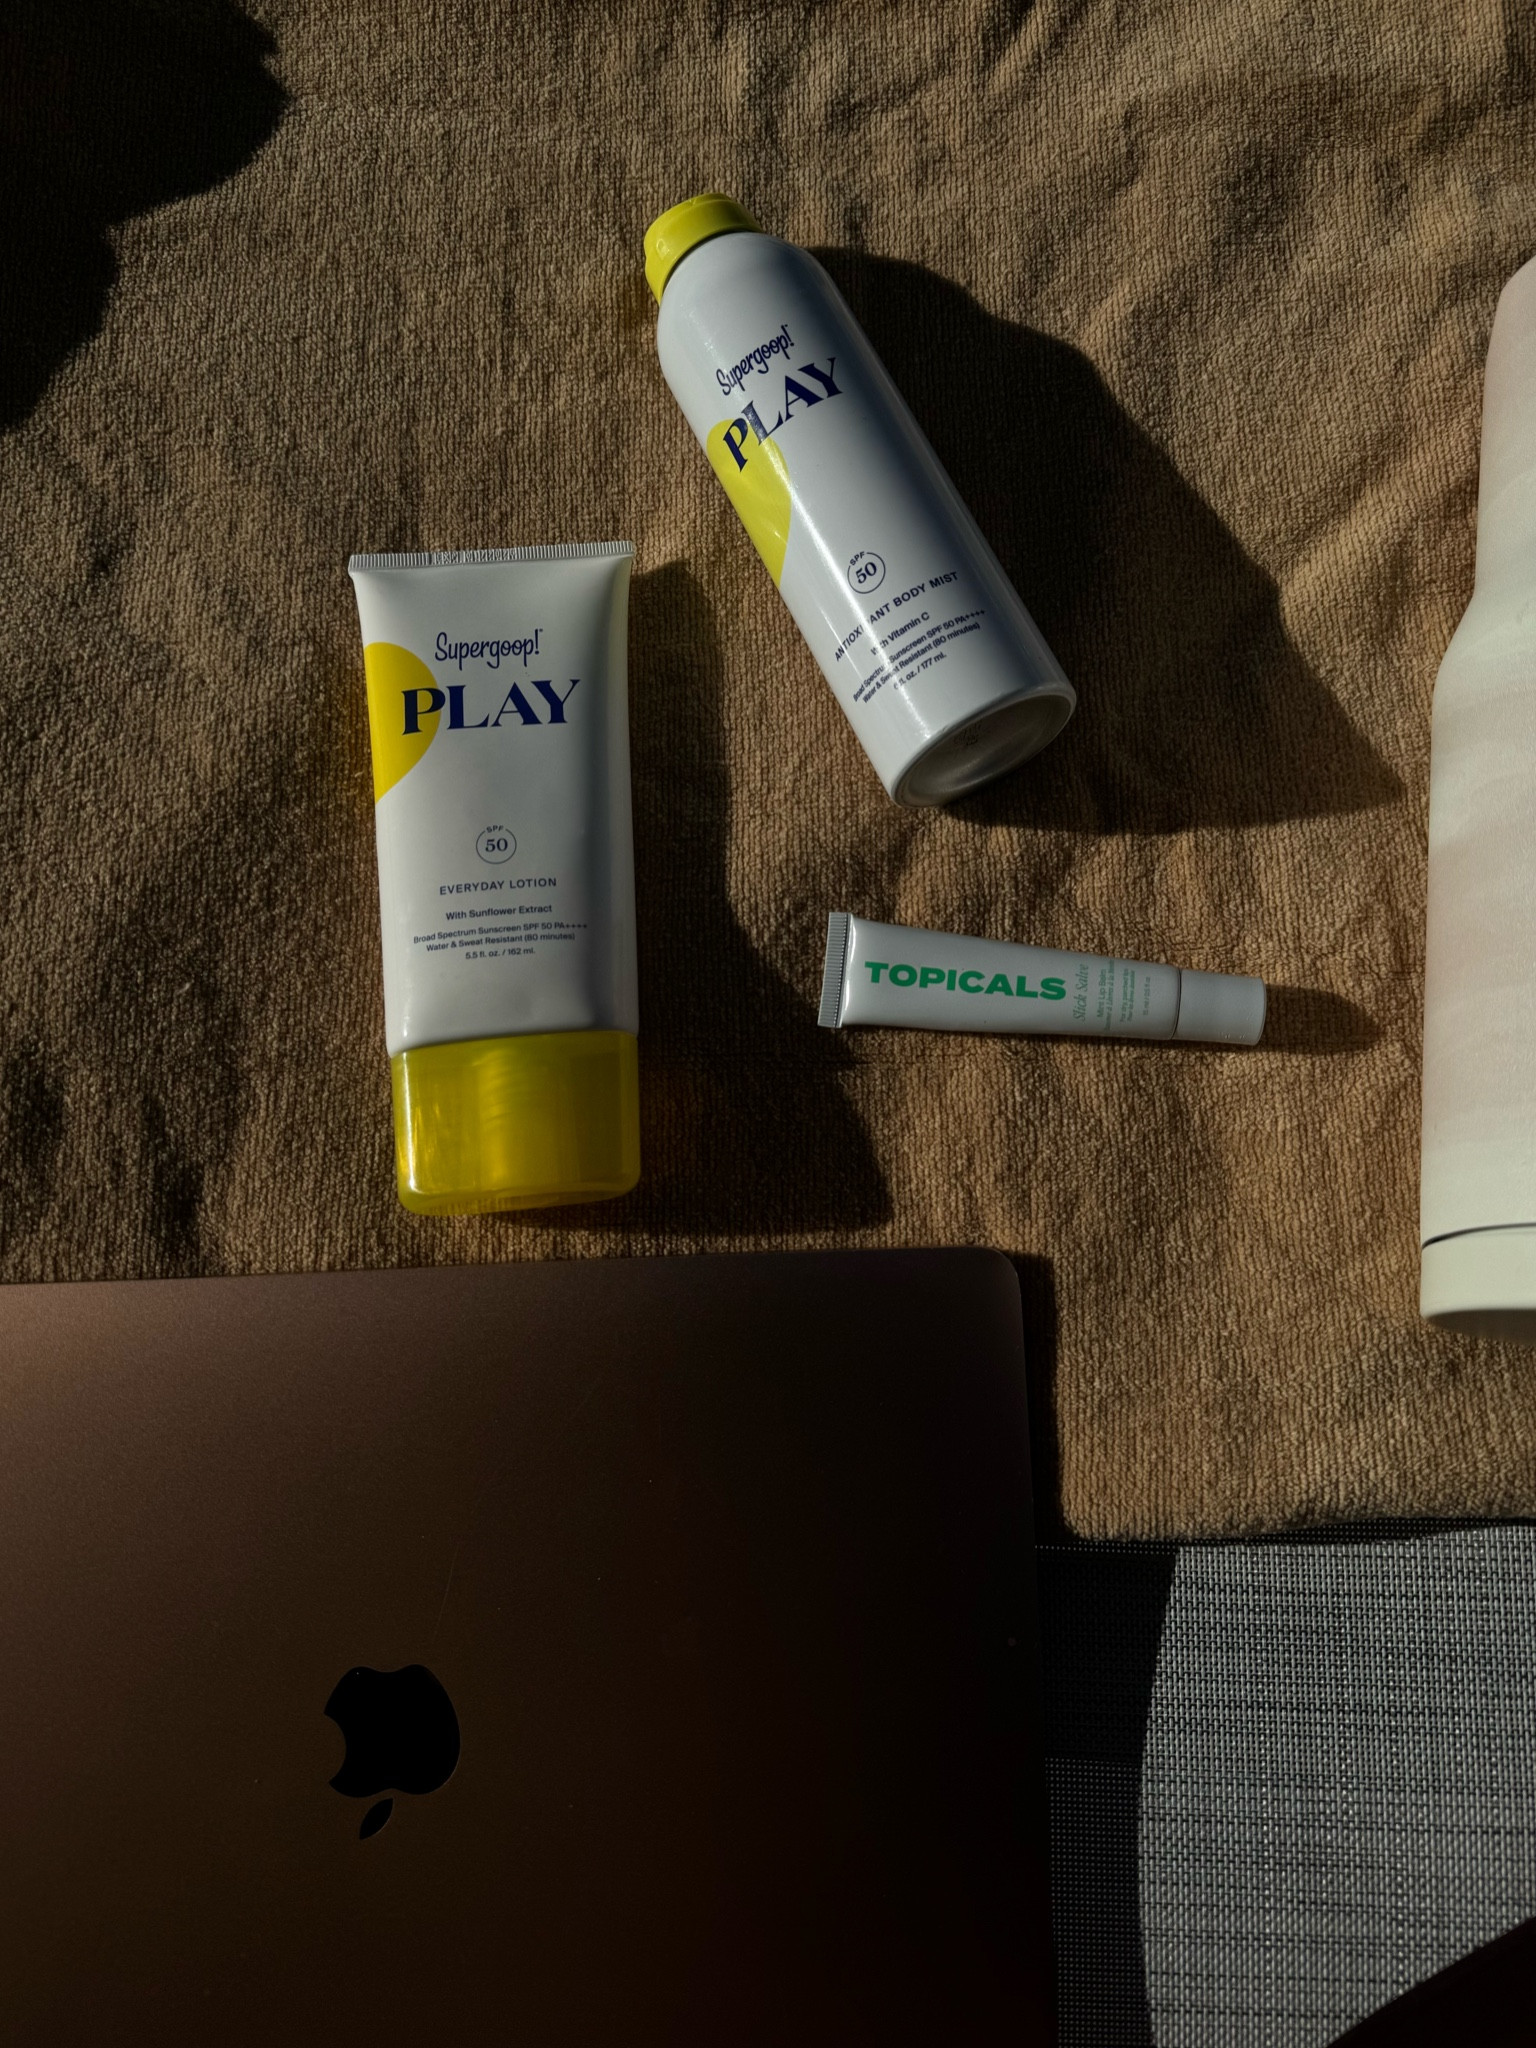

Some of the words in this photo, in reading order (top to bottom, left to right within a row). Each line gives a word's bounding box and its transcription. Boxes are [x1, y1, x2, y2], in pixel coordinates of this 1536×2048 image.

[716, 324, 795, 396] Supergoop!
[722, 357, 843, 472] PLAY
[849, 551, 865, 566] SPF
[855, 561, 877, 584] 50
[834, 602, 890, 662] ANTIOXIANT
[893, 583, 926, 608] BODY
[929, 571, 959, 589] MIST
[887, 617, 921, 641] Vitamin
[921, 611, 930, 621] C
[434, 628, 540, 671] Supergoop!
[863, 661, 889, 687] Spectru
[889, 635, 927, 663] Sunscreen
[926, 624, 943, 638] SPF
[942, 620, 955, 630] 50
[899, 642, 933, 670] Resistant
[932, 635, 947, 648] (80
[947, 622, 981, 641] minutes)
[921, 657, 933, 670] 177
[401, 678, 581, 736] PLAY
[486, 824, 505, 834] SPF
[485, 837, 509, 853] 50
[439, 880, 505, 896] EVERYDAY
[509, 877, 557, 889] LOTION
[445, 909, 467, 921] With
[468, 905, 516, 919] Sunflower
[519, 904, 553, 914] Extract
[413, 933, 436, 944] Broad
[437, 928, 477, 940] Spectrum
[478, 924, 522, 935] Sunscreen
[523, 922, 540, 931] SPF
[541, 921, 553, 930] 50
[426, 942, 449, 952] Water
[451, 940, 457, 949] &
[458, 938, 484, 948] Sweat
[485, 935, 523, 945] Resistant
[524, 933, 538, 943] (80
[540, 932, 576, 941] minutes)
[465, 951, 478, 960] 5.5
[508, 947, 521, 956] 162
[864, 960, 1067, 1001] TOPICALS
